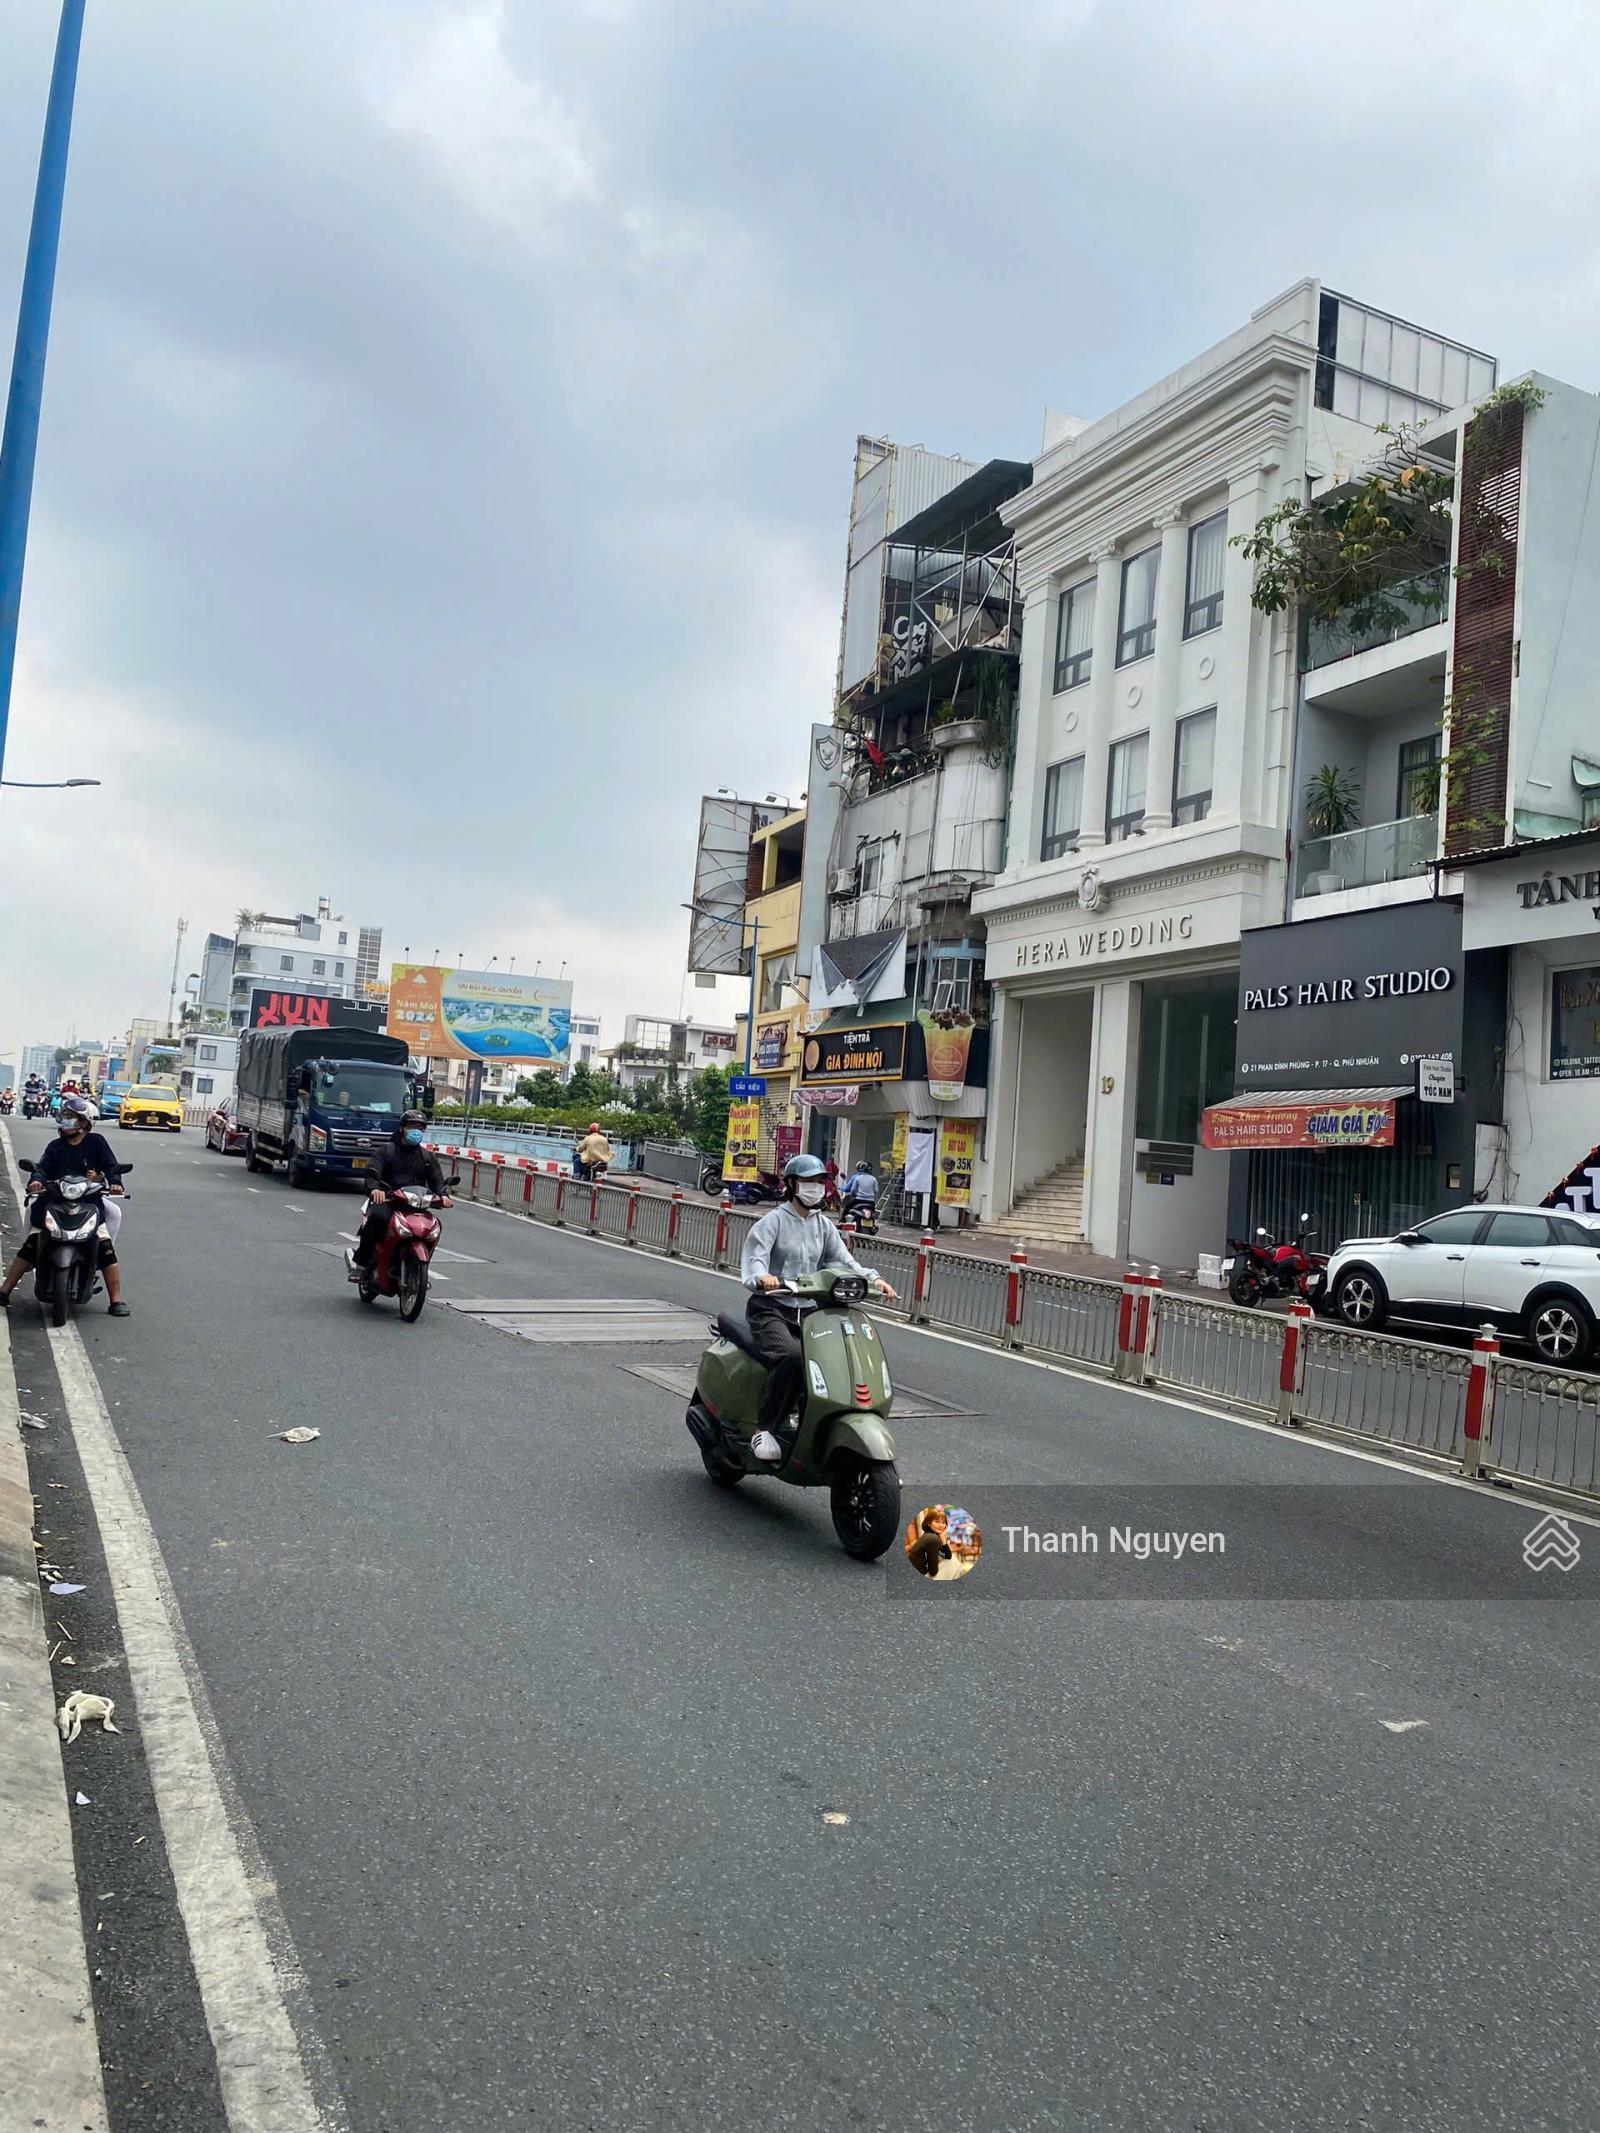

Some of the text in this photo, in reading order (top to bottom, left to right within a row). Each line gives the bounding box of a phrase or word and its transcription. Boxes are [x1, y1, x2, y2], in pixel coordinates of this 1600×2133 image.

[1016, 914, 1193, 966] HERA WEDDING
[1244, 967, 1451, 1010] PALS HAIR STUDIO
[826, 1054, 841, 1071] GIA
[866, 1047, 883, 1071] NỘI
[1250, 1064, 1257, 1072] 21
[1258, 1063, 1274, 1071] PHAN
[1342, 1056, 1355, 1066] PHÚ
[1101, 1076, 1114, 1094] 19
[1438, 1086, 1452, 1098] NAM
[1213, 1123, 1294, 1137] PALS HAIR STUDIO
[1366, 1114, 1390, 1133] 50%
[742, 1139, 757, 1150] 35K
[957, 1157, 972, 1170] 35K
